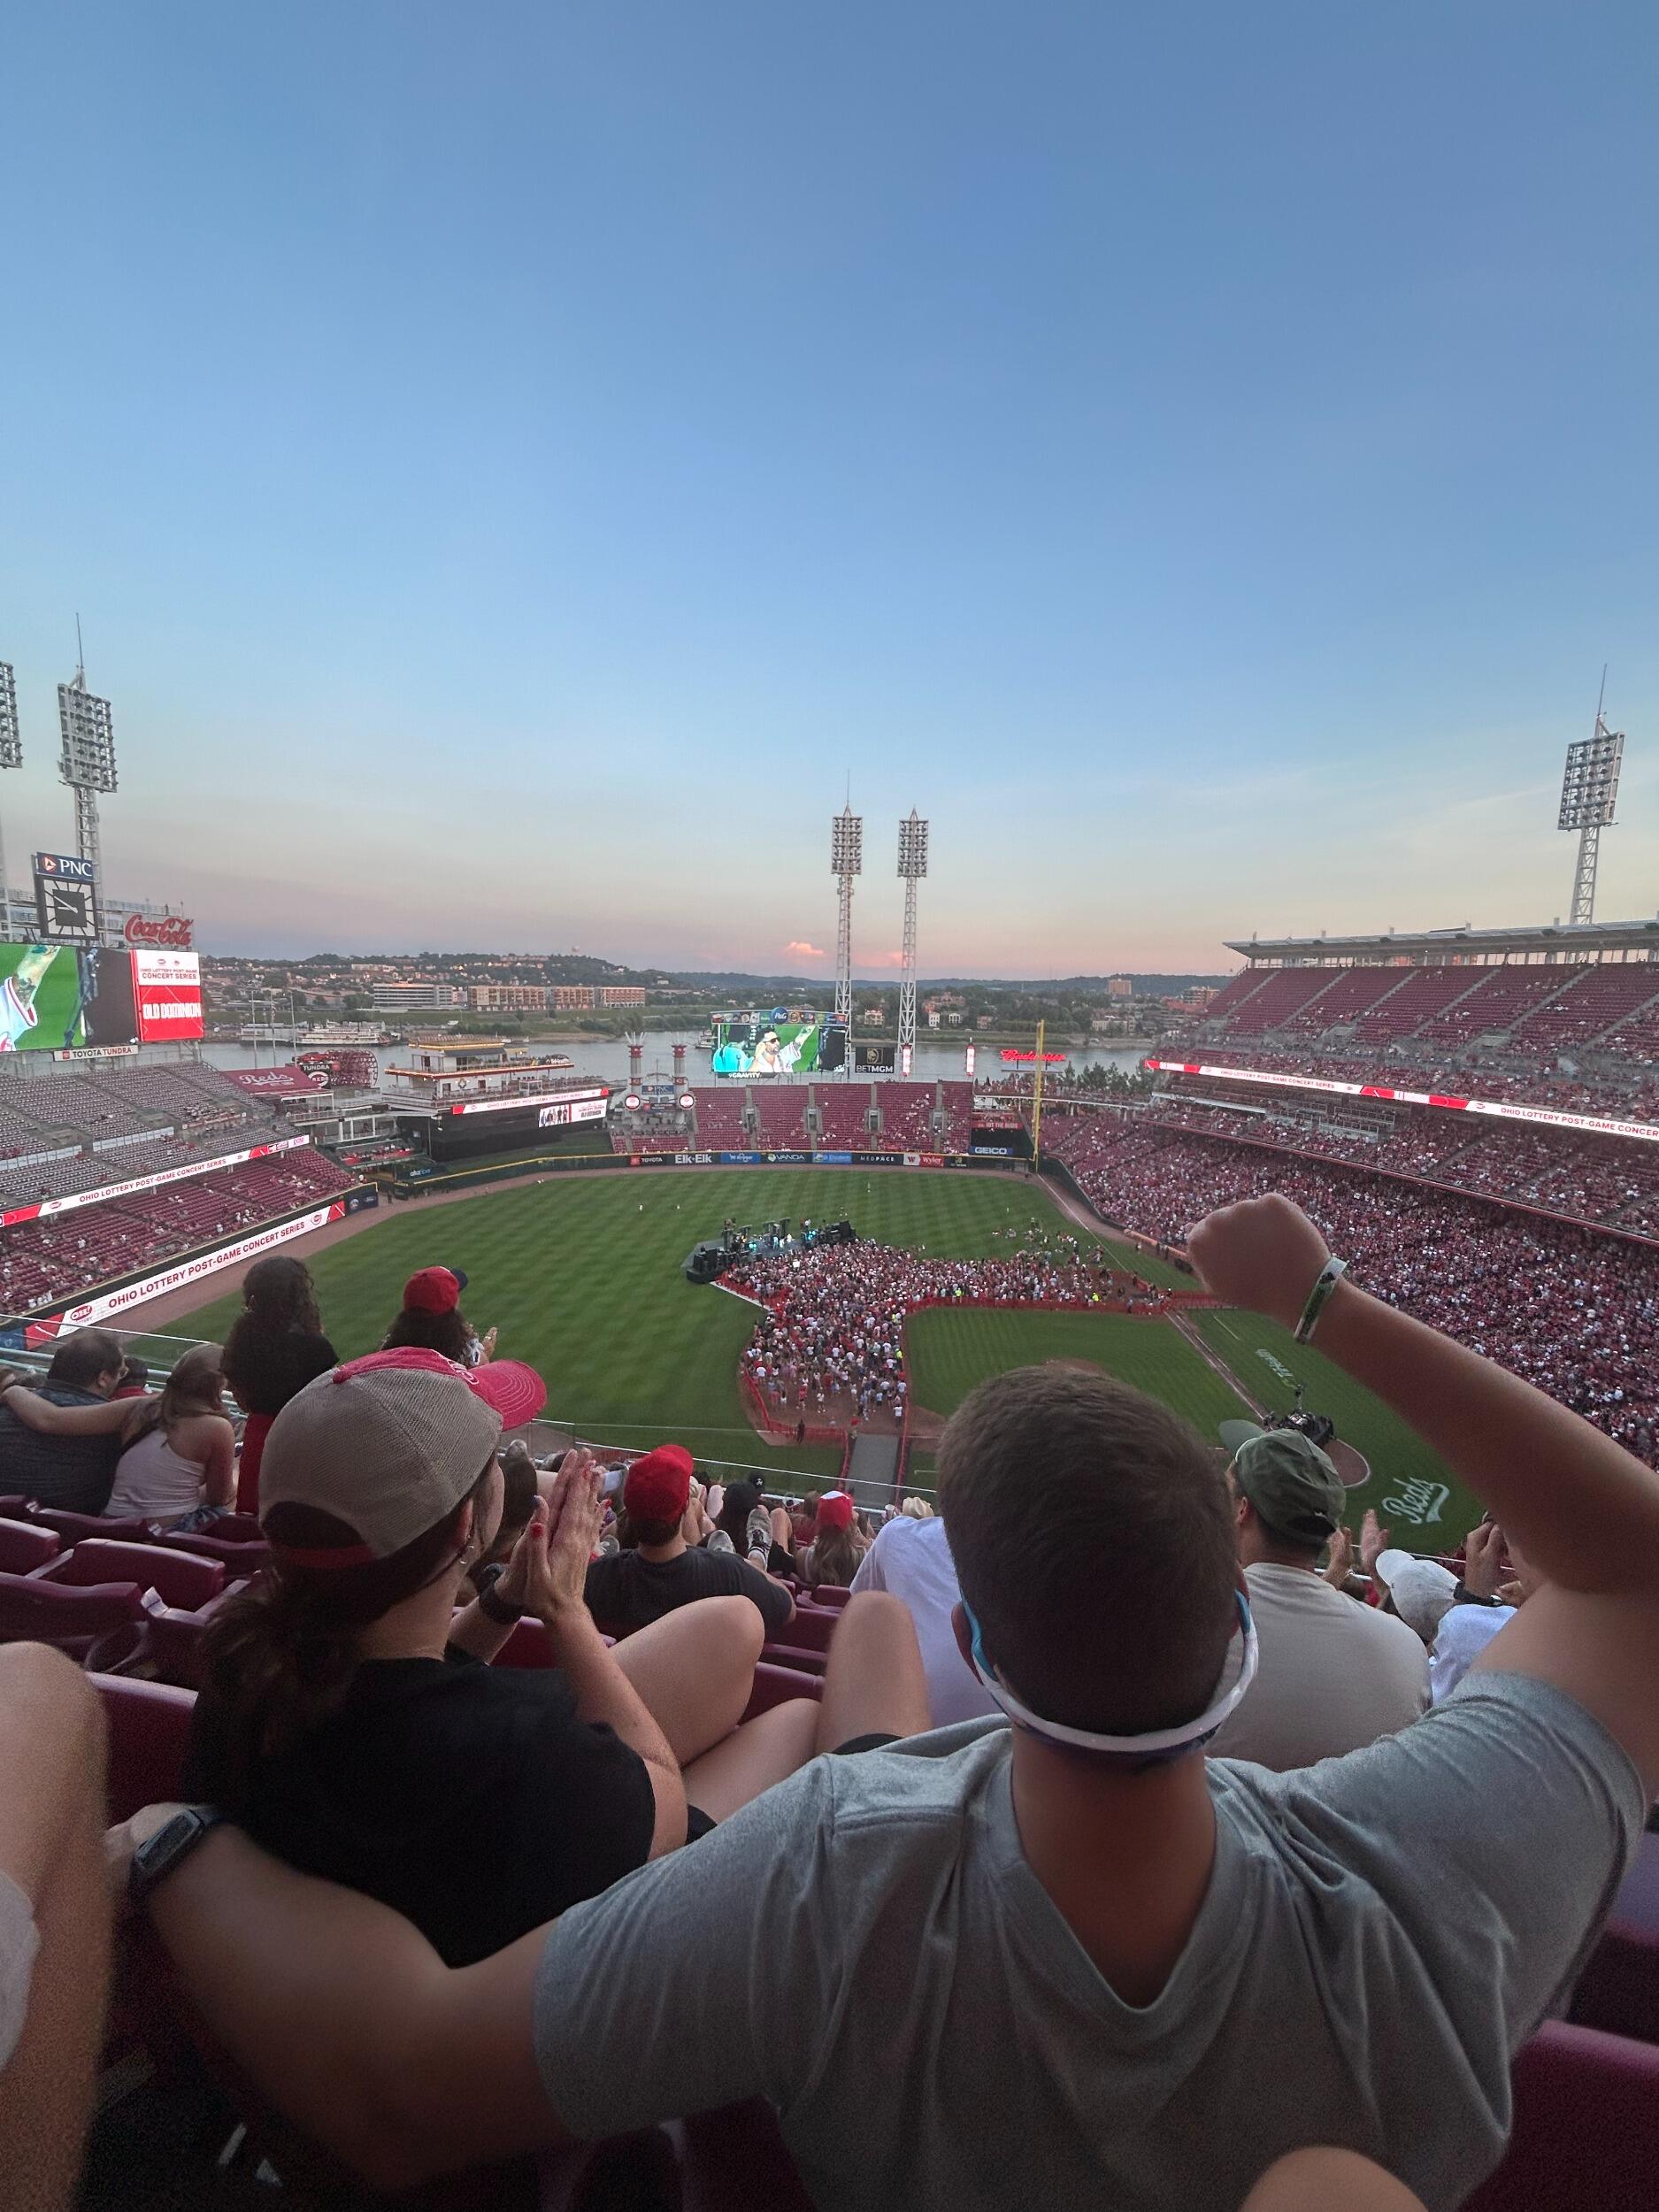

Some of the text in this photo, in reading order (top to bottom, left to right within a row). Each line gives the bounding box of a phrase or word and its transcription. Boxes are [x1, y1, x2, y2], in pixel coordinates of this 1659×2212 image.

[58, 858, 92, 876] PNC
[125, 914, 194, 945] Coca-Cola
[143, 1002, 201, 1019] OLD DOMINION
[239, 1071, 294, 1086] Reds
[1257, 1074, 1286, 1084] POST-GAME
[1501, 1107, 1520, 1116] OHIO
[1522, 1110, 1560, 1122] LOTTERY
[1562, 1117, 1616, 1131] POST-GAME
[923, 1156, 941, 1165] Wyler
[80, 1159, 227, 1202] OHIO LOTTERY POST-GAME CONCERT SERIES
[109, 1221, 305, 1309] OHIO LOTTERY POST-GAME CONCERT SERIES
[1381, 1477, 1449, 1525] Reds
